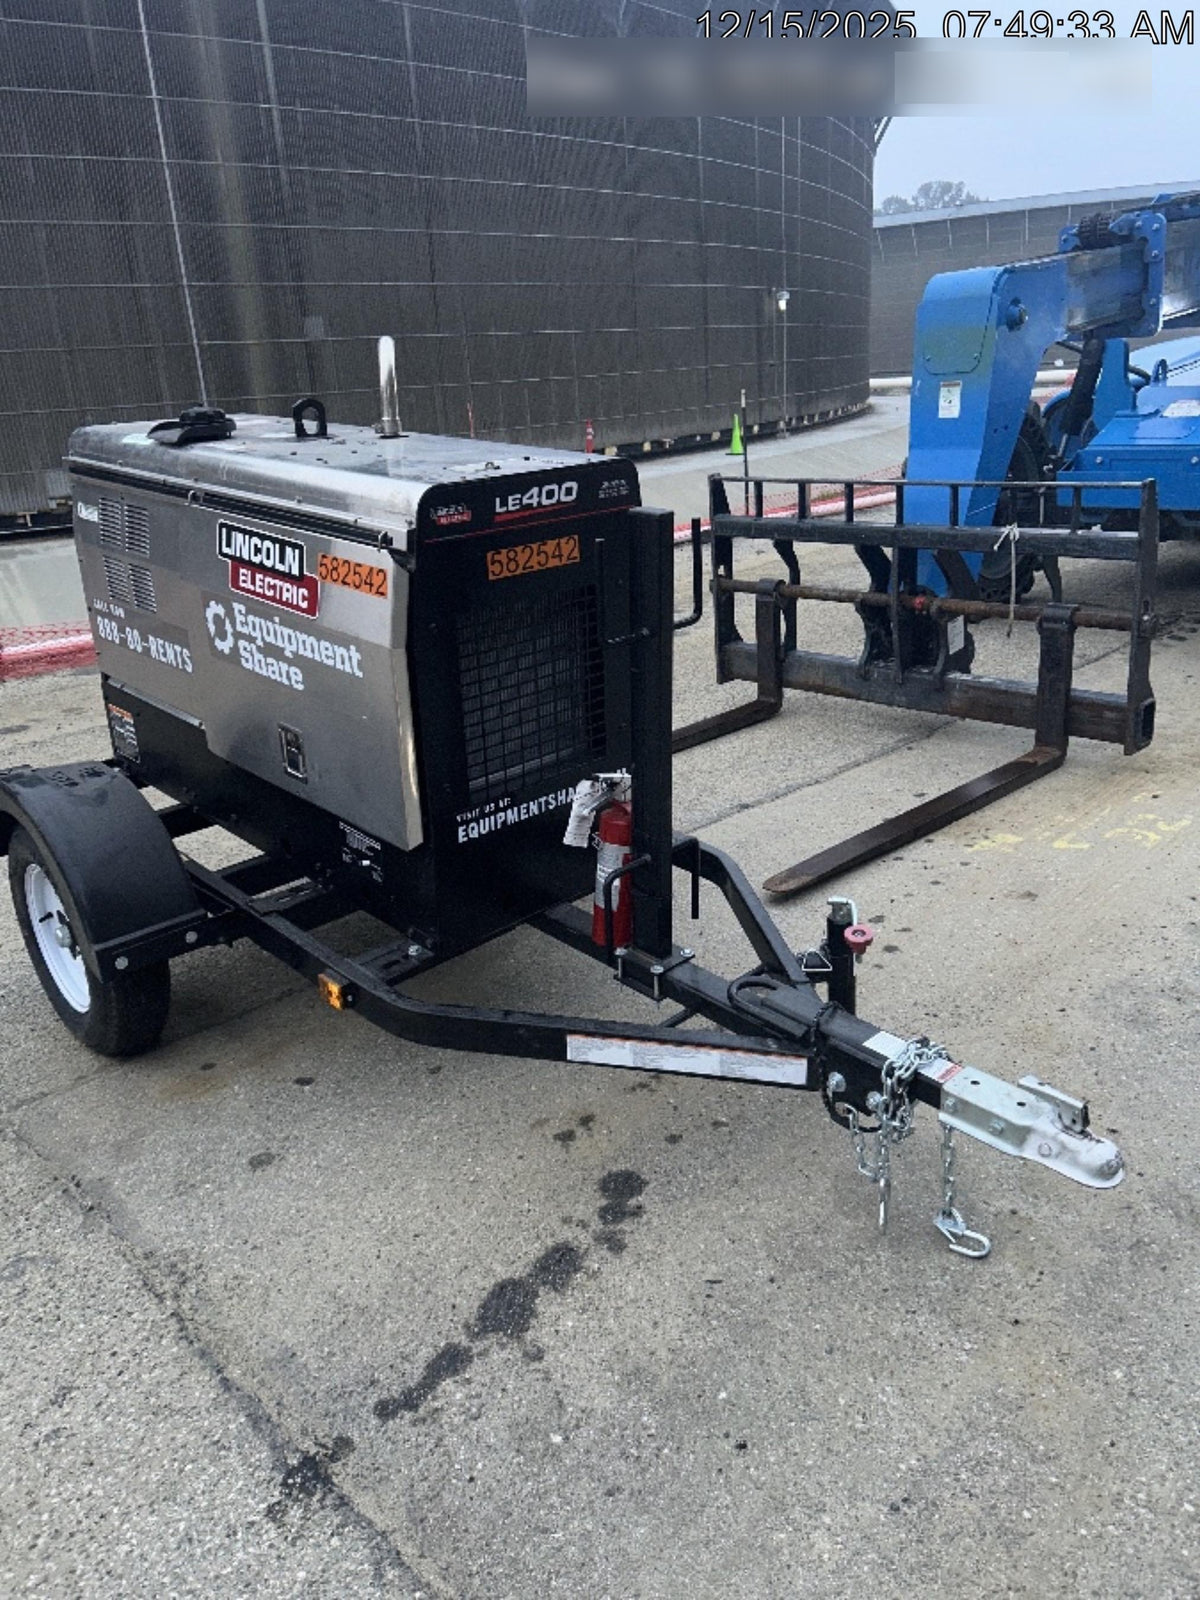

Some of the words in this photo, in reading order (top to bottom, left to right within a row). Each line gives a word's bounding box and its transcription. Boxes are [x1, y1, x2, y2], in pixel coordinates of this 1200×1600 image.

[494, 481, 579, 513] LE400
[221, 527, 300, 577] LINCOLN
[318, 553, 388, 597] 582542
[489, 536, 579, 577] 582542
[238, 567, 309, 609] ELECTRIC
[96, 614, 193, 674] 888-80-RENTS
[232, 601, 364, 678] Equipment
[237, 638, 305, 691] Share
